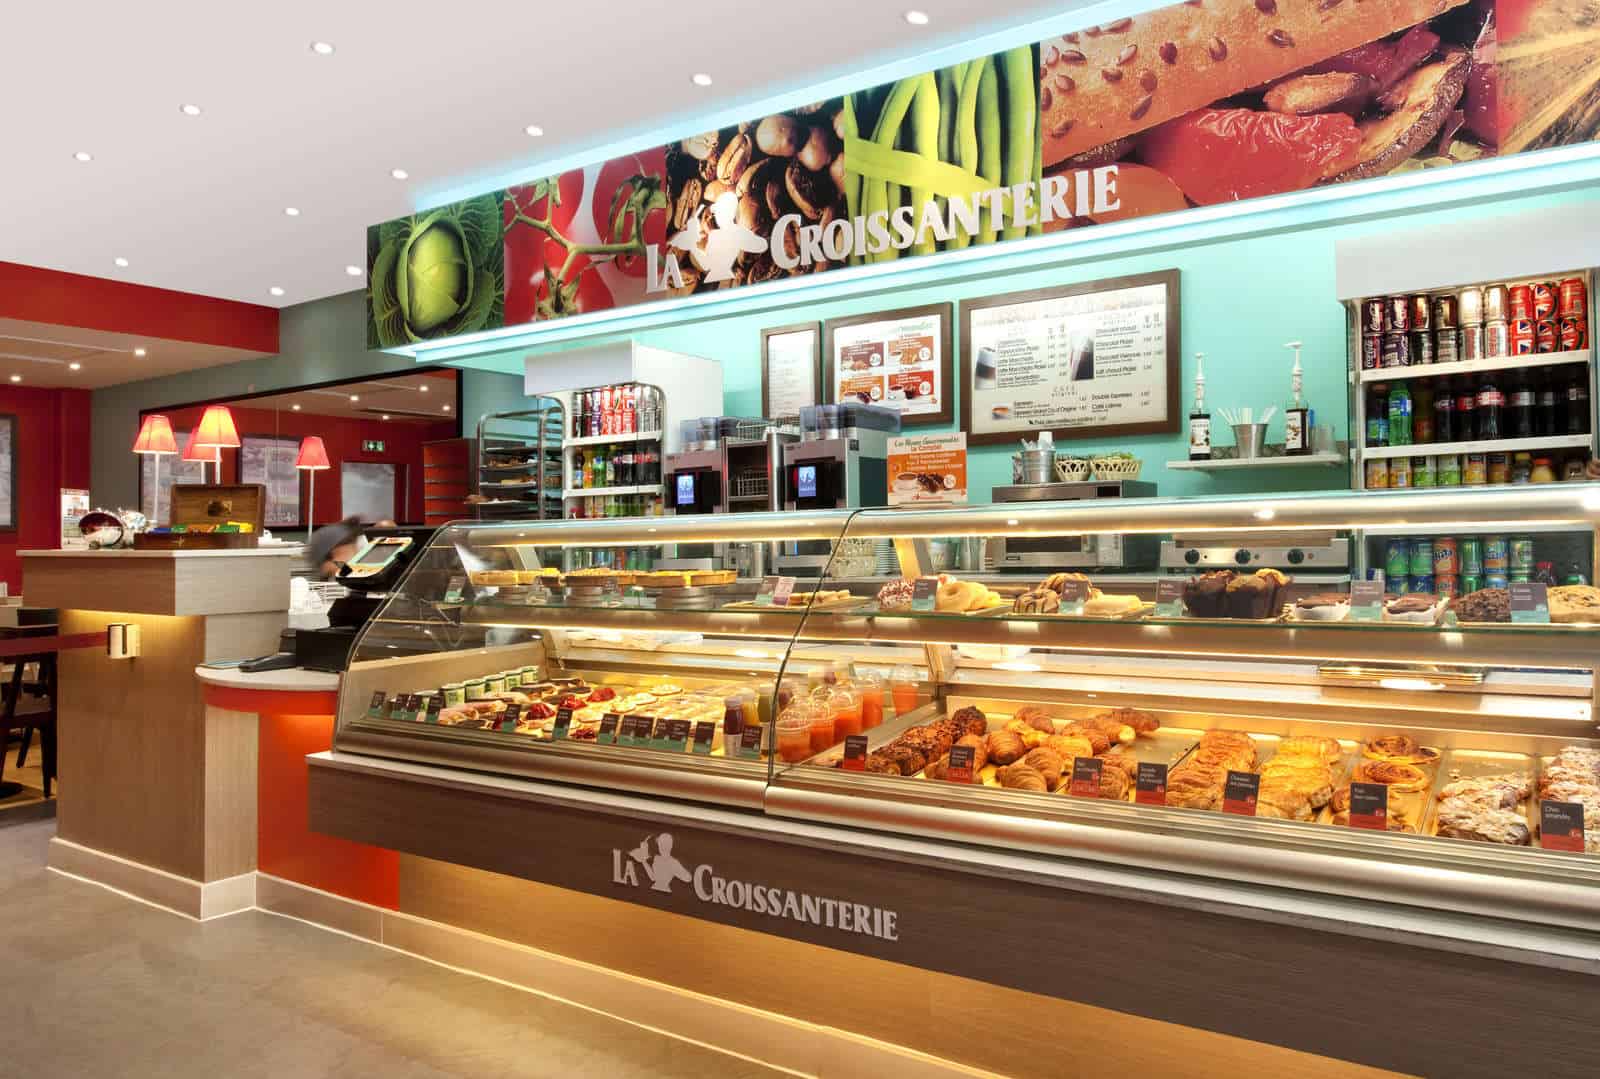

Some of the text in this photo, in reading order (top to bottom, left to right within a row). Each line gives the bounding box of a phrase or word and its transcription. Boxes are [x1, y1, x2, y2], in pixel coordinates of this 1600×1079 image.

[646, 165, 1121, 294] LA CROISSANTERIE
[612, 848, 899, 941] LA CROISSANTERIE
